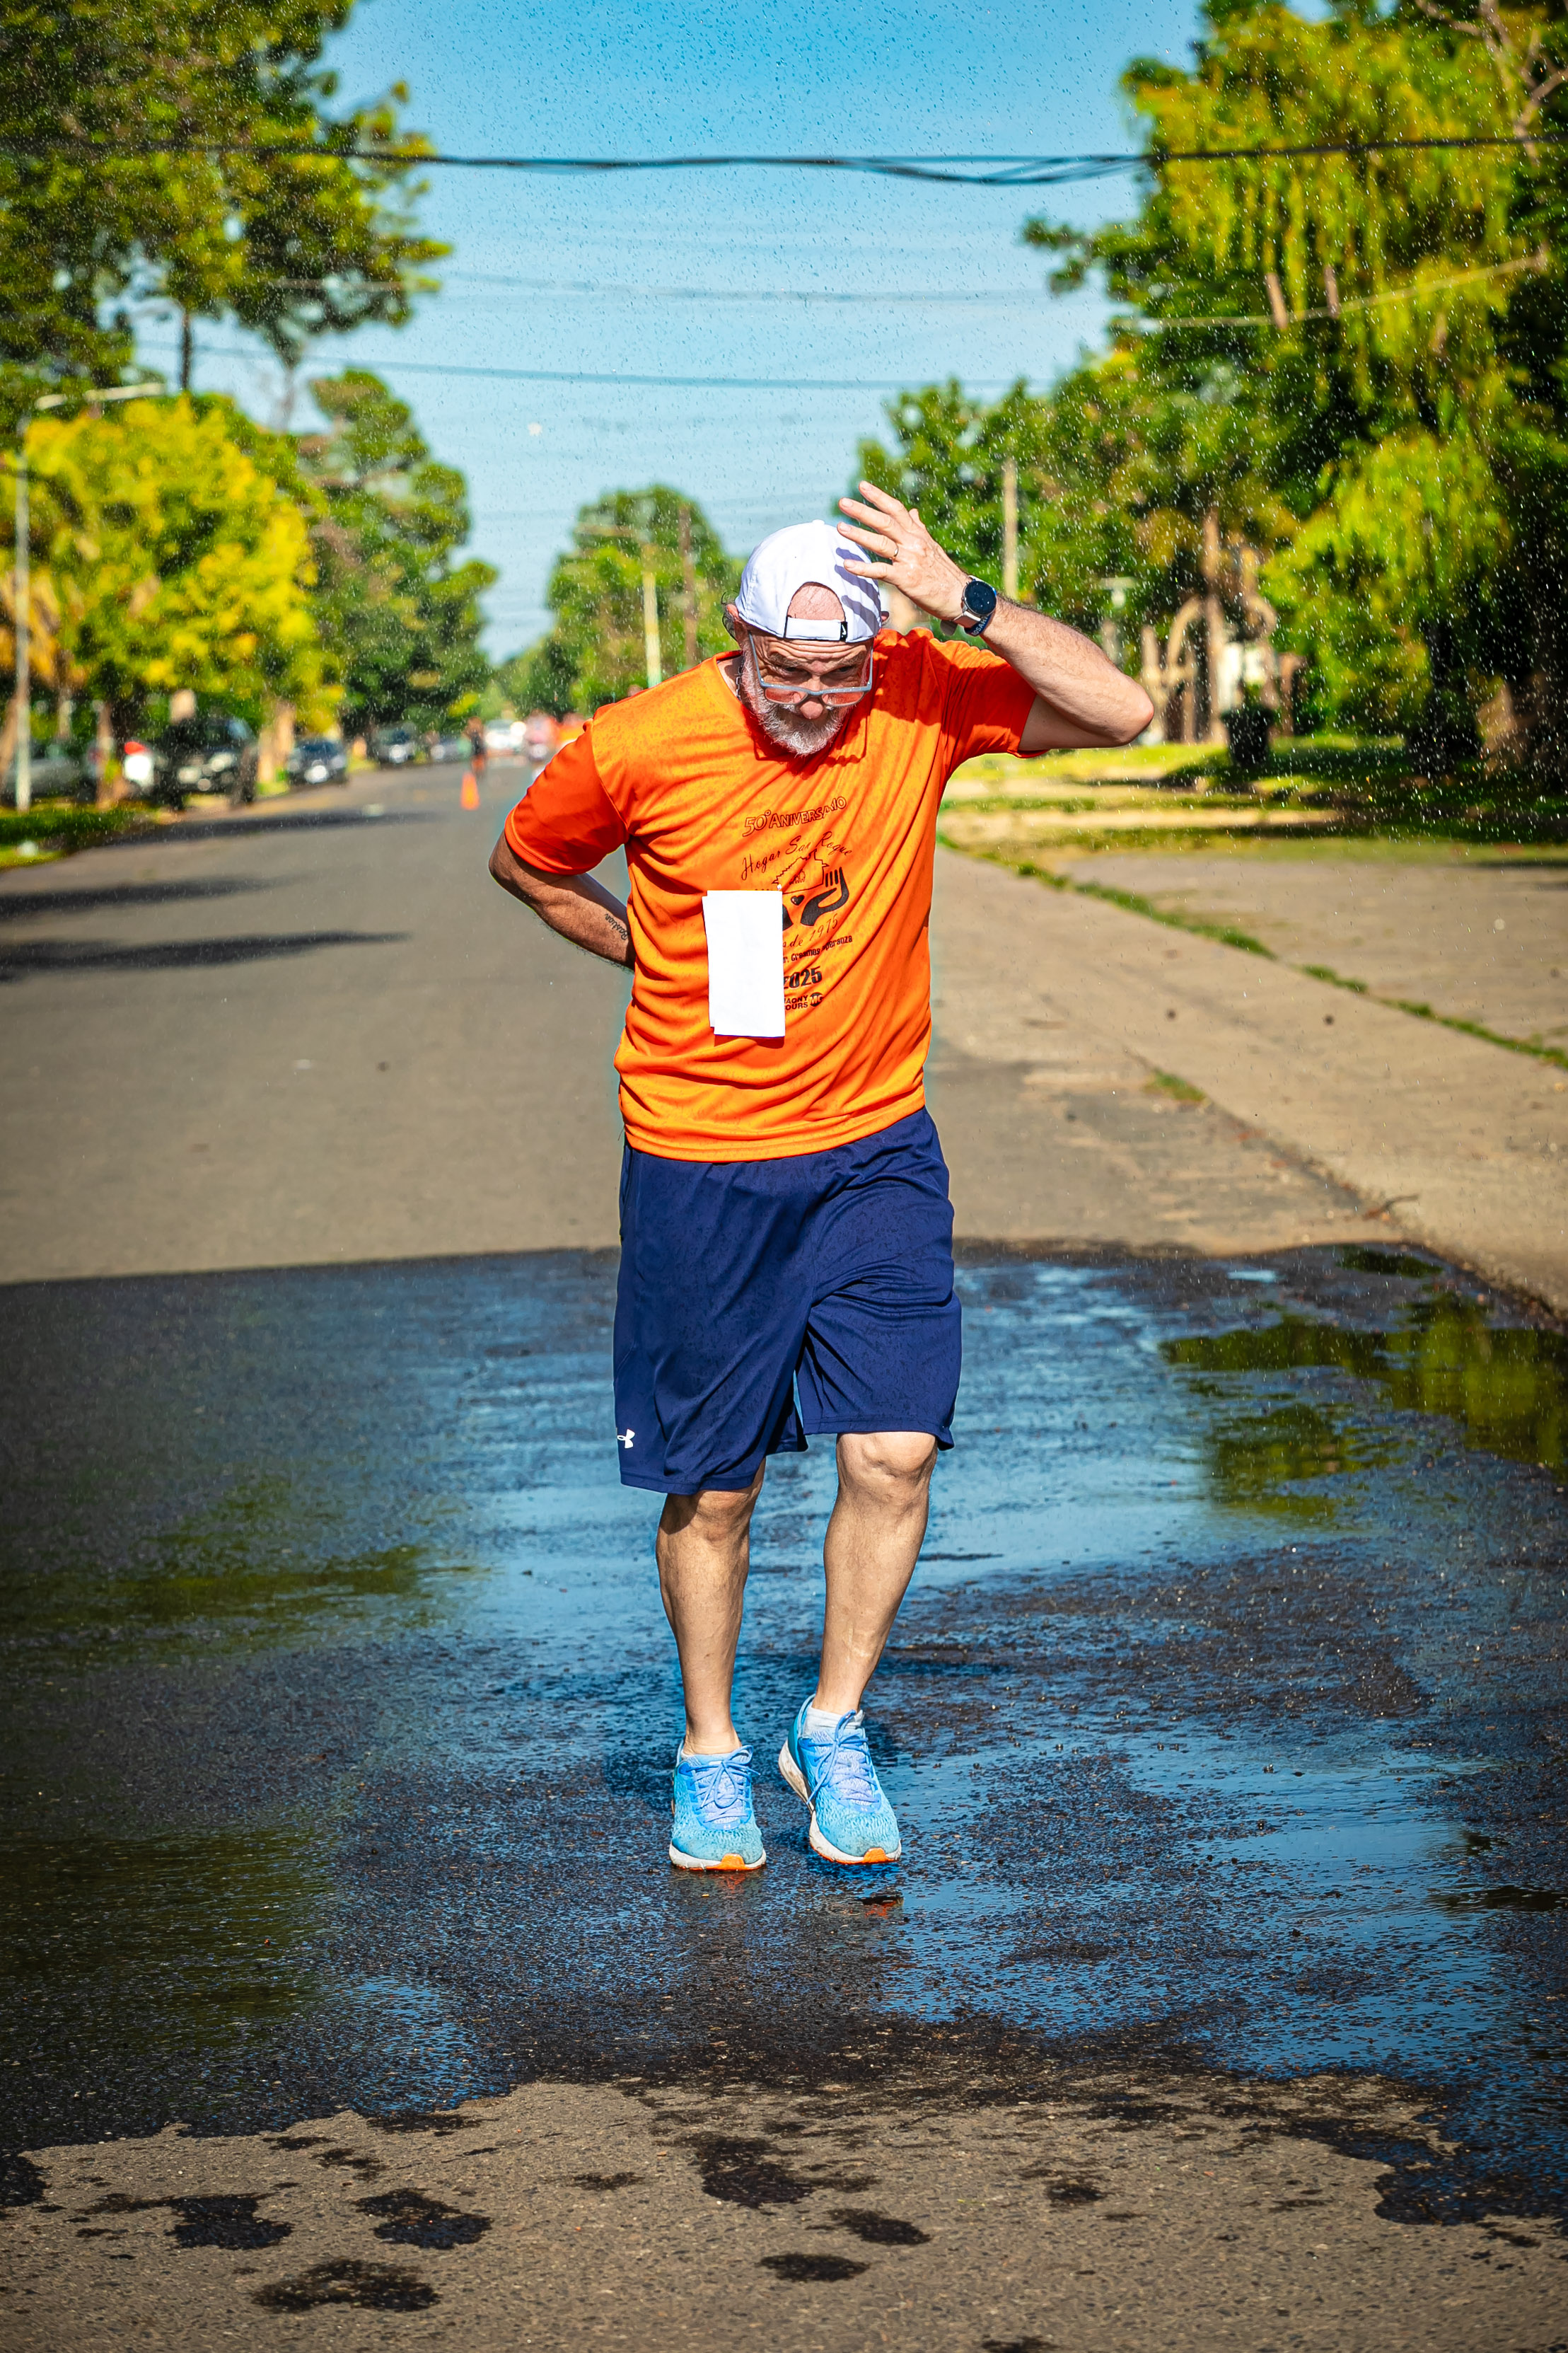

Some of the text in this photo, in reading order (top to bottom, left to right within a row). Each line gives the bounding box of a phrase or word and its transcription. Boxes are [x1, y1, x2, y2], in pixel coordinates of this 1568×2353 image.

[741, 831, 852, 881] Hogar San Roque
[783, 913, 838, 947] sde 1975
[821, 935, 853, 952] peranza
[784, 966, 823, 989] 2025
[784, 995, 808, 1004] AGNY
[785, 1002, 808, 1010] OURS
